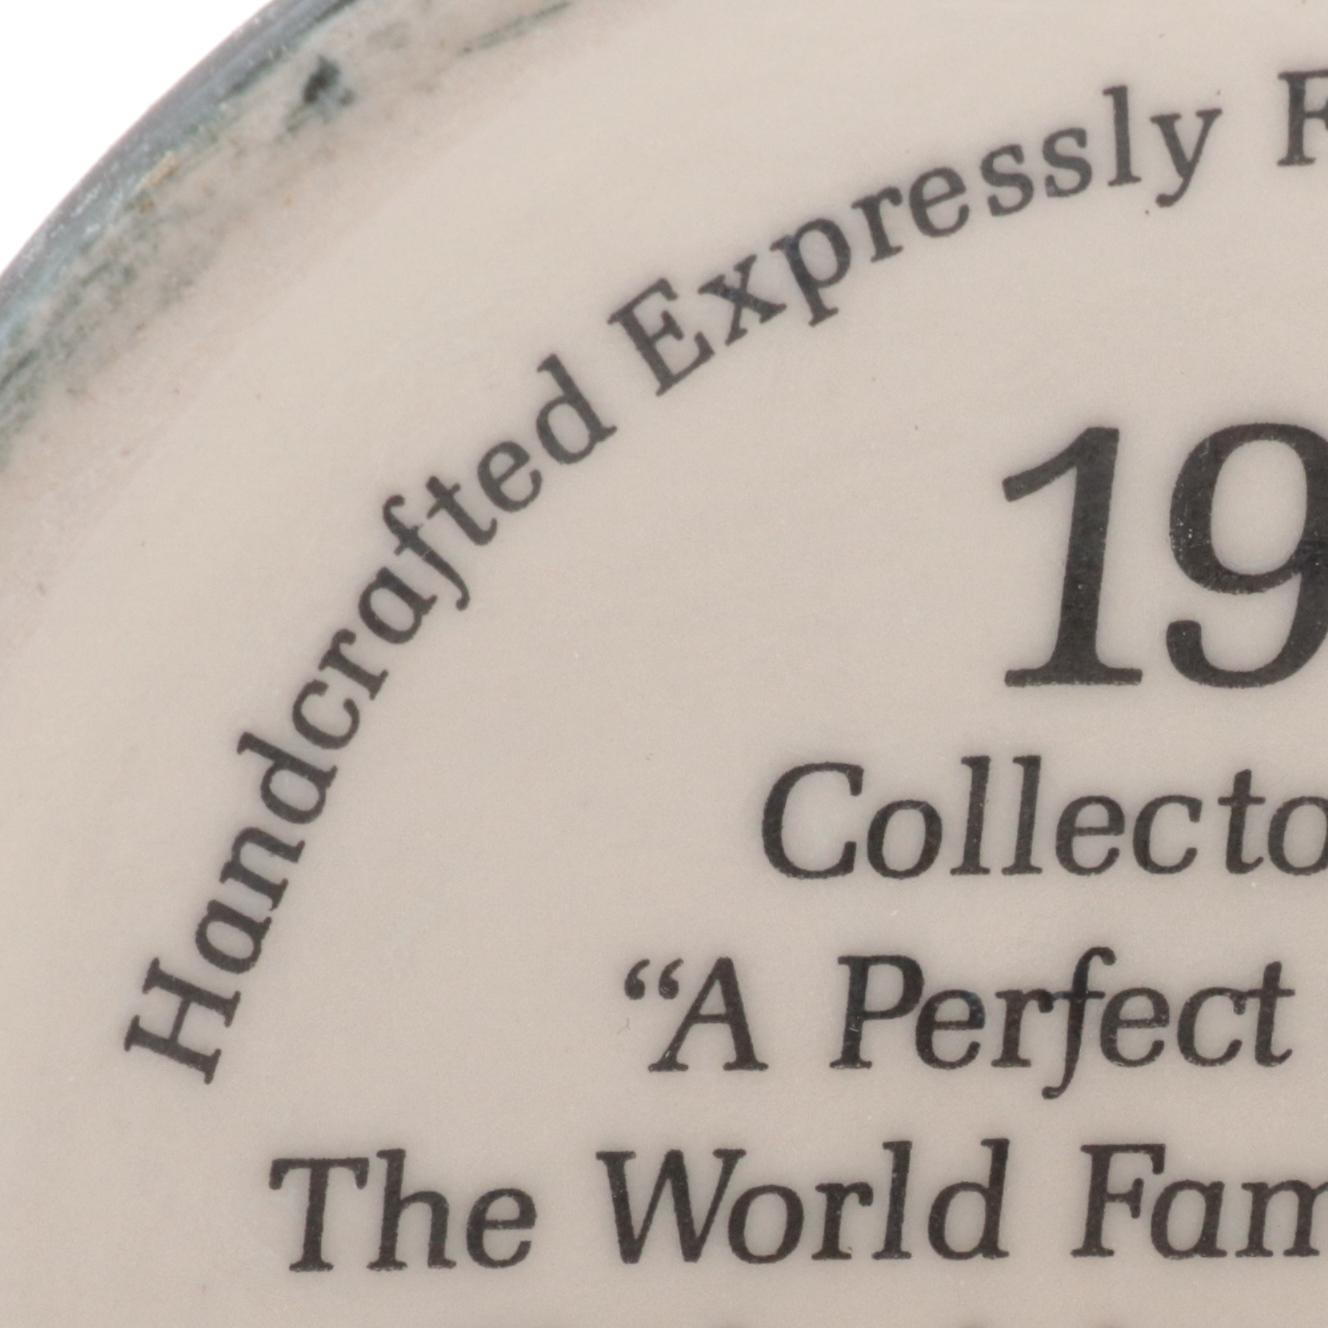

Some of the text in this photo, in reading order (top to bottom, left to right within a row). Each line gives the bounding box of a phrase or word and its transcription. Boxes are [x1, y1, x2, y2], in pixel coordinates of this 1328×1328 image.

[122, 353, 618, 1086] Handcrafted
[606, 84, 1223, 397] Expressly
[828, 944, 1297, 1101] Perfect
[267, 1146, 539, 1274] The
[594, 1136, 1012, 1266] World
